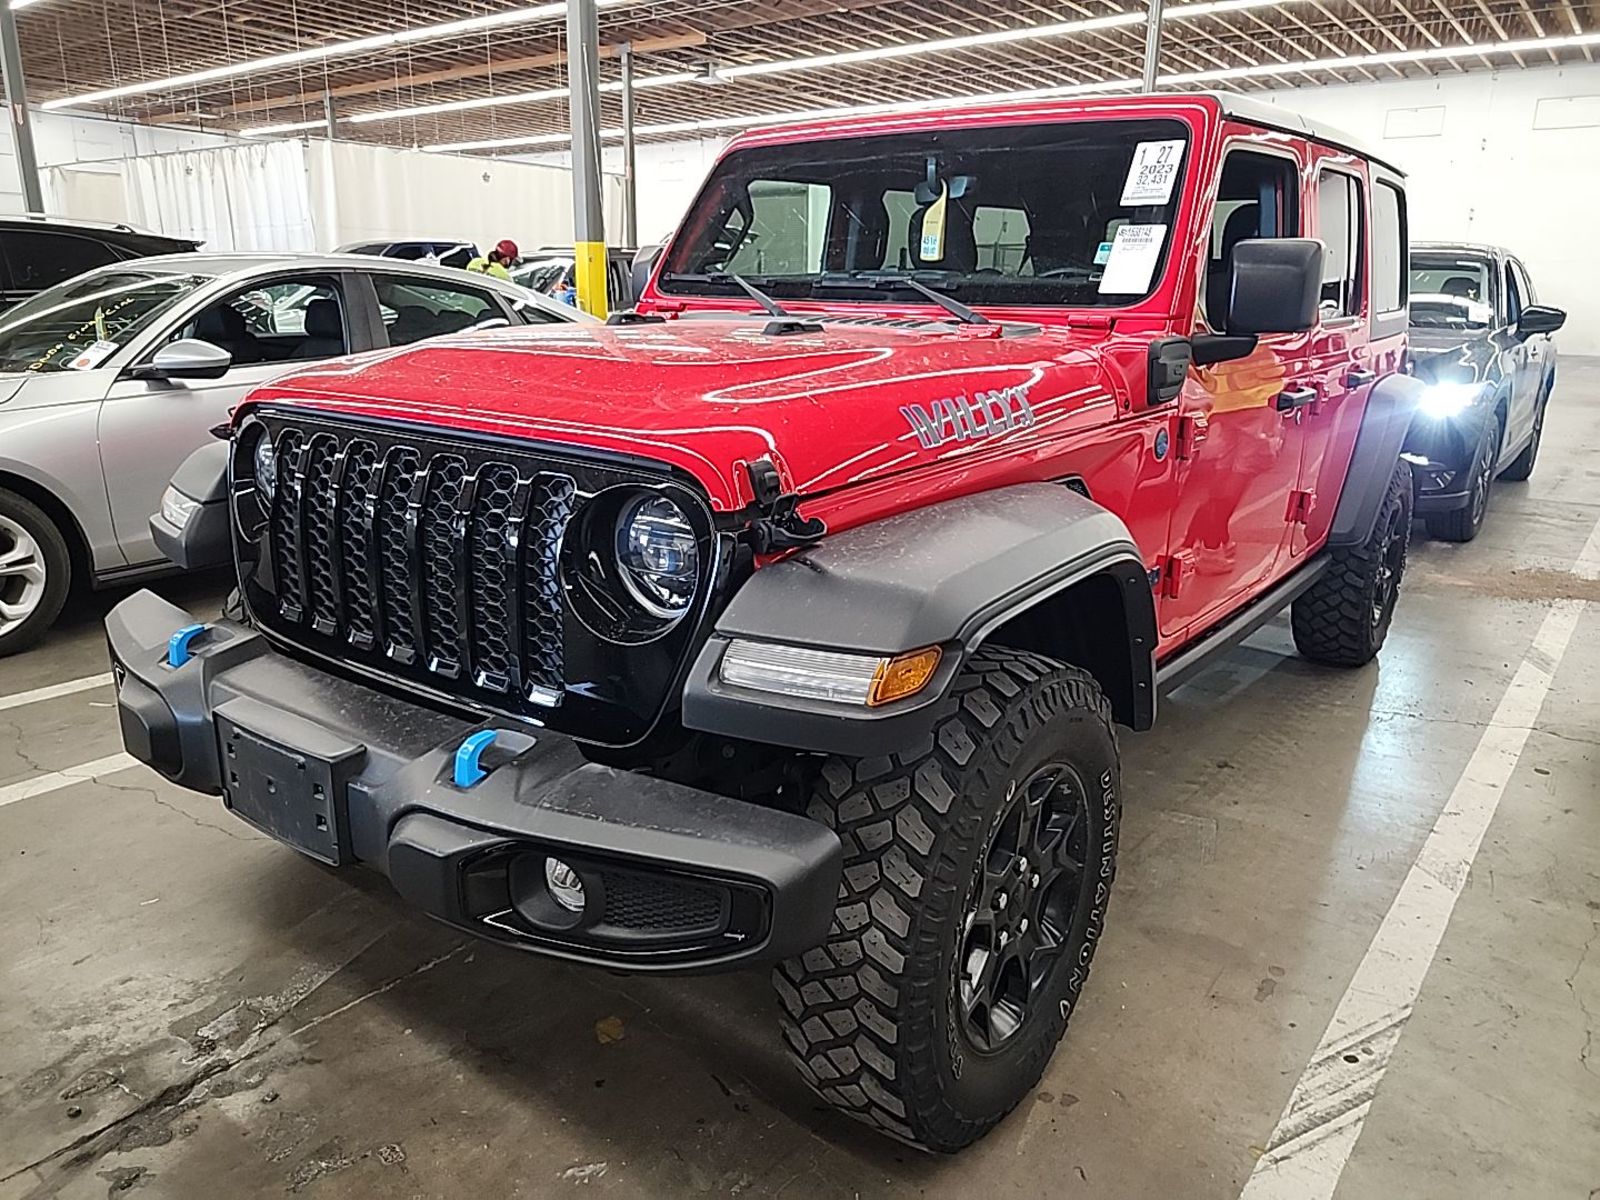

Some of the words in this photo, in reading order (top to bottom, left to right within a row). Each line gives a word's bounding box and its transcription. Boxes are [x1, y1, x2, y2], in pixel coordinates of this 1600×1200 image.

[1156, 145, 1174, 164] 27
[1139, 163, 1175, 175] 2023
[1135, 174, 1168, 187] 32,431
